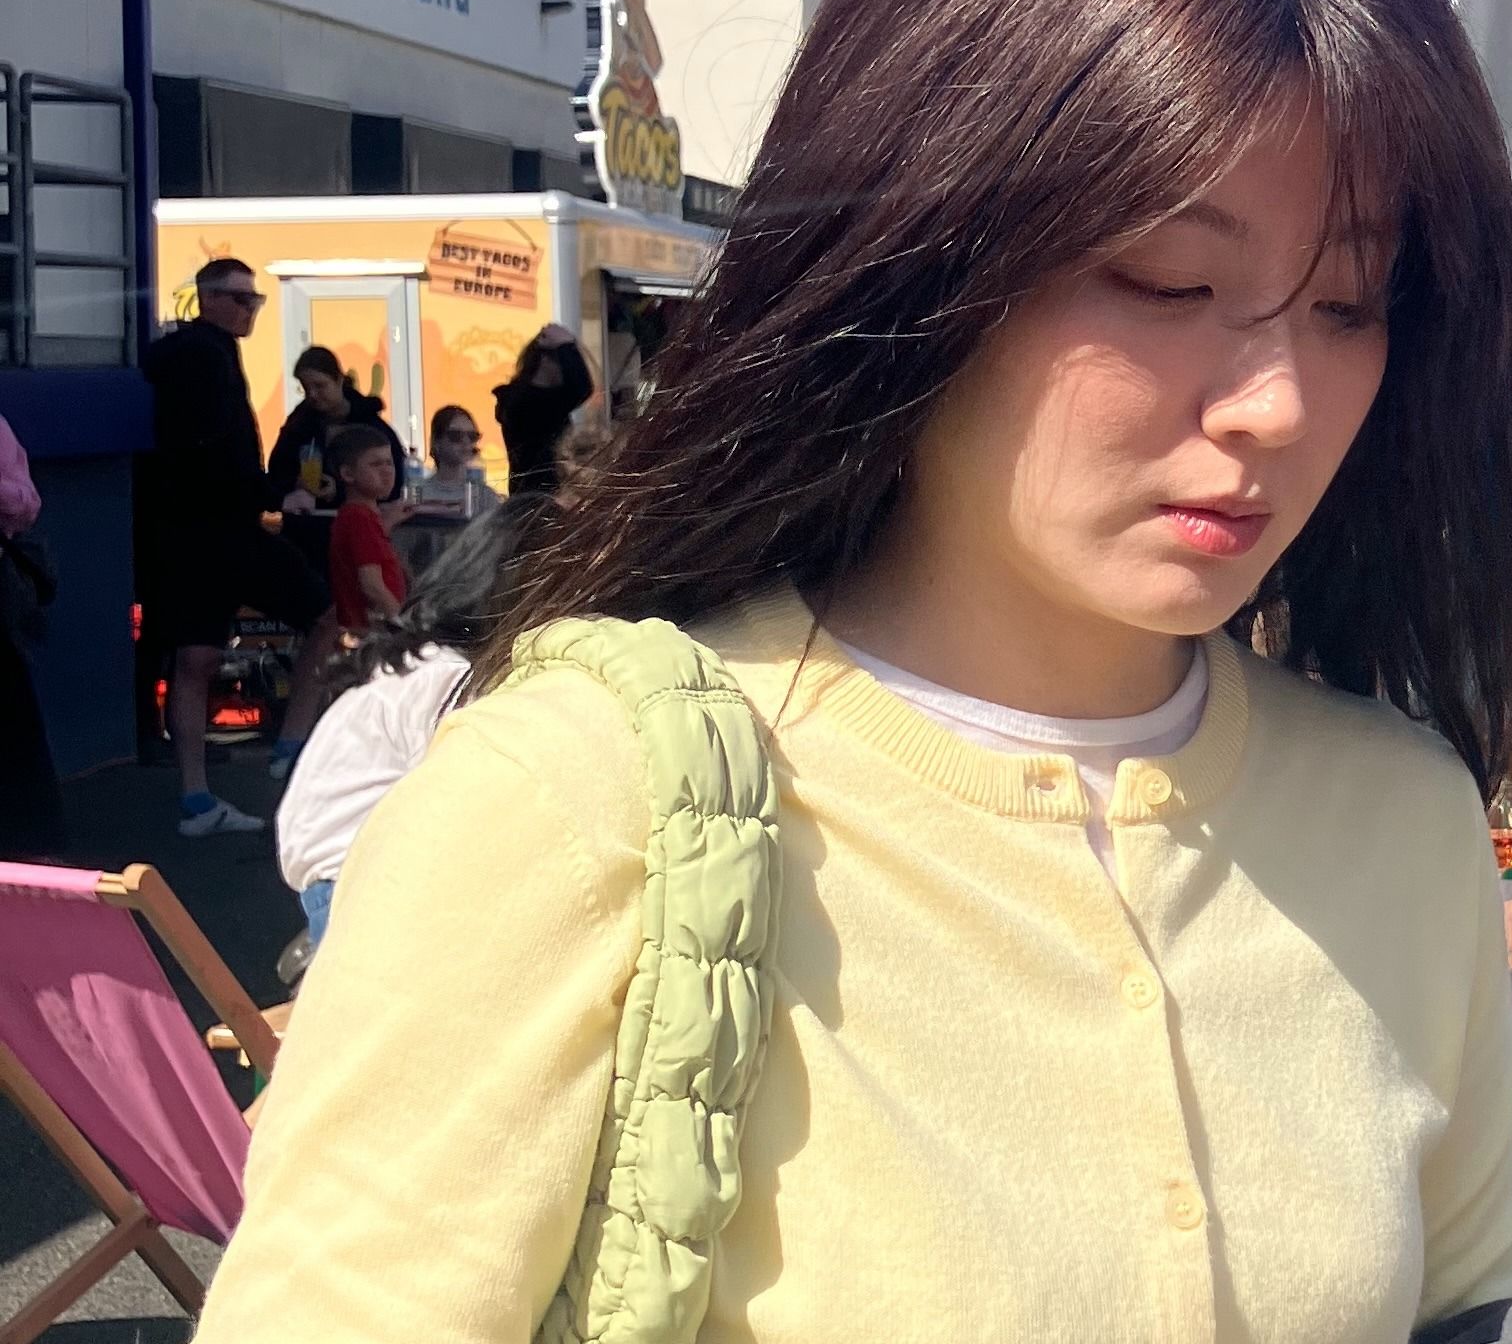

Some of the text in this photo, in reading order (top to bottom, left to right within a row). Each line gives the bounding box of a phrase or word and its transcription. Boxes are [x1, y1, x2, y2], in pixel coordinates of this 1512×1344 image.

[442, 243, 531, 272] BEST TACOS
[476, 266, 492, 277] IN
[454, 278, 511, 299] EUROPE
